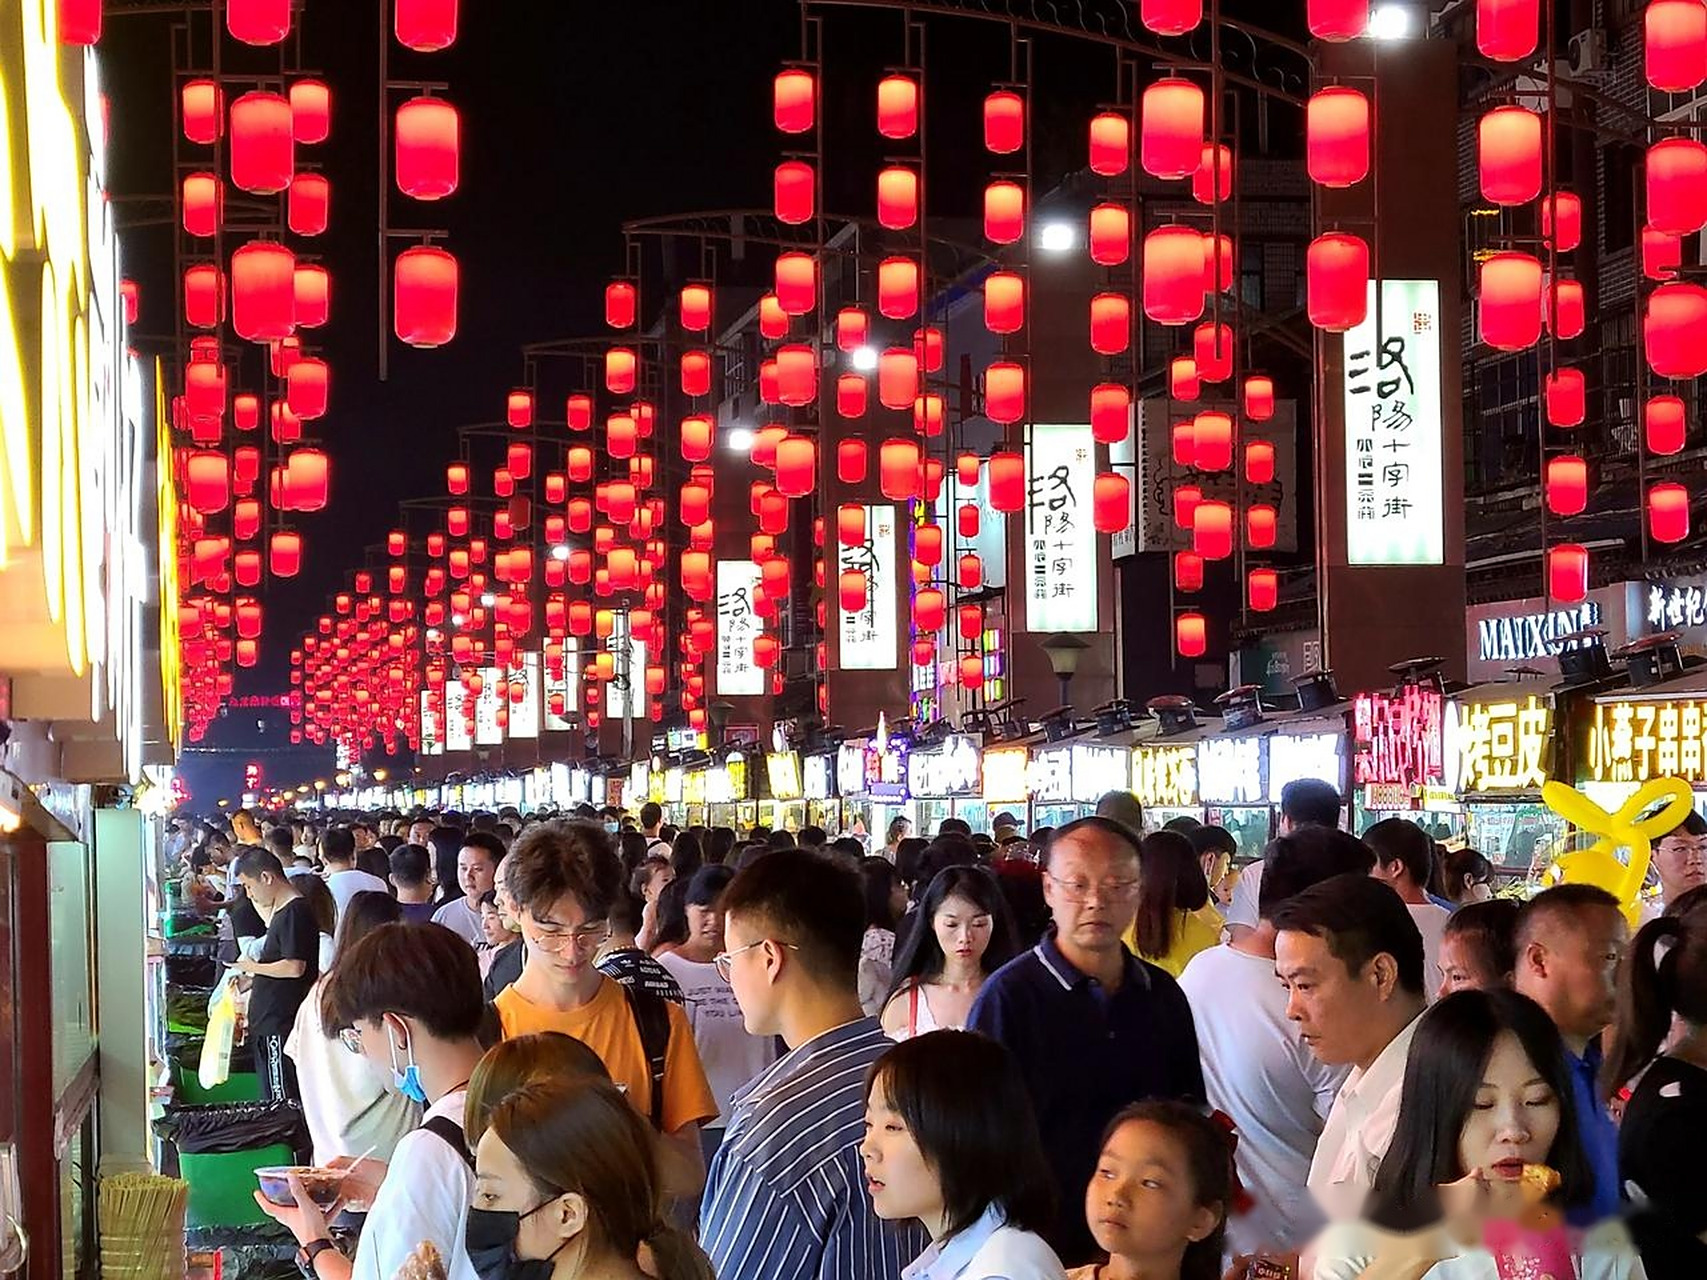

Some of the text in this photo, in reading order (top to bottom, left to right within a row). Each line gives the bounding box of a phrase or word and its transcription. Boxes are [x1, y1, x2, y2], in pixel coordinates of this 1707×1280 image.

[1458, 695, 1548, 793] 烤豆皮
[1588, 700, 1707, 782] 小燕子串串
